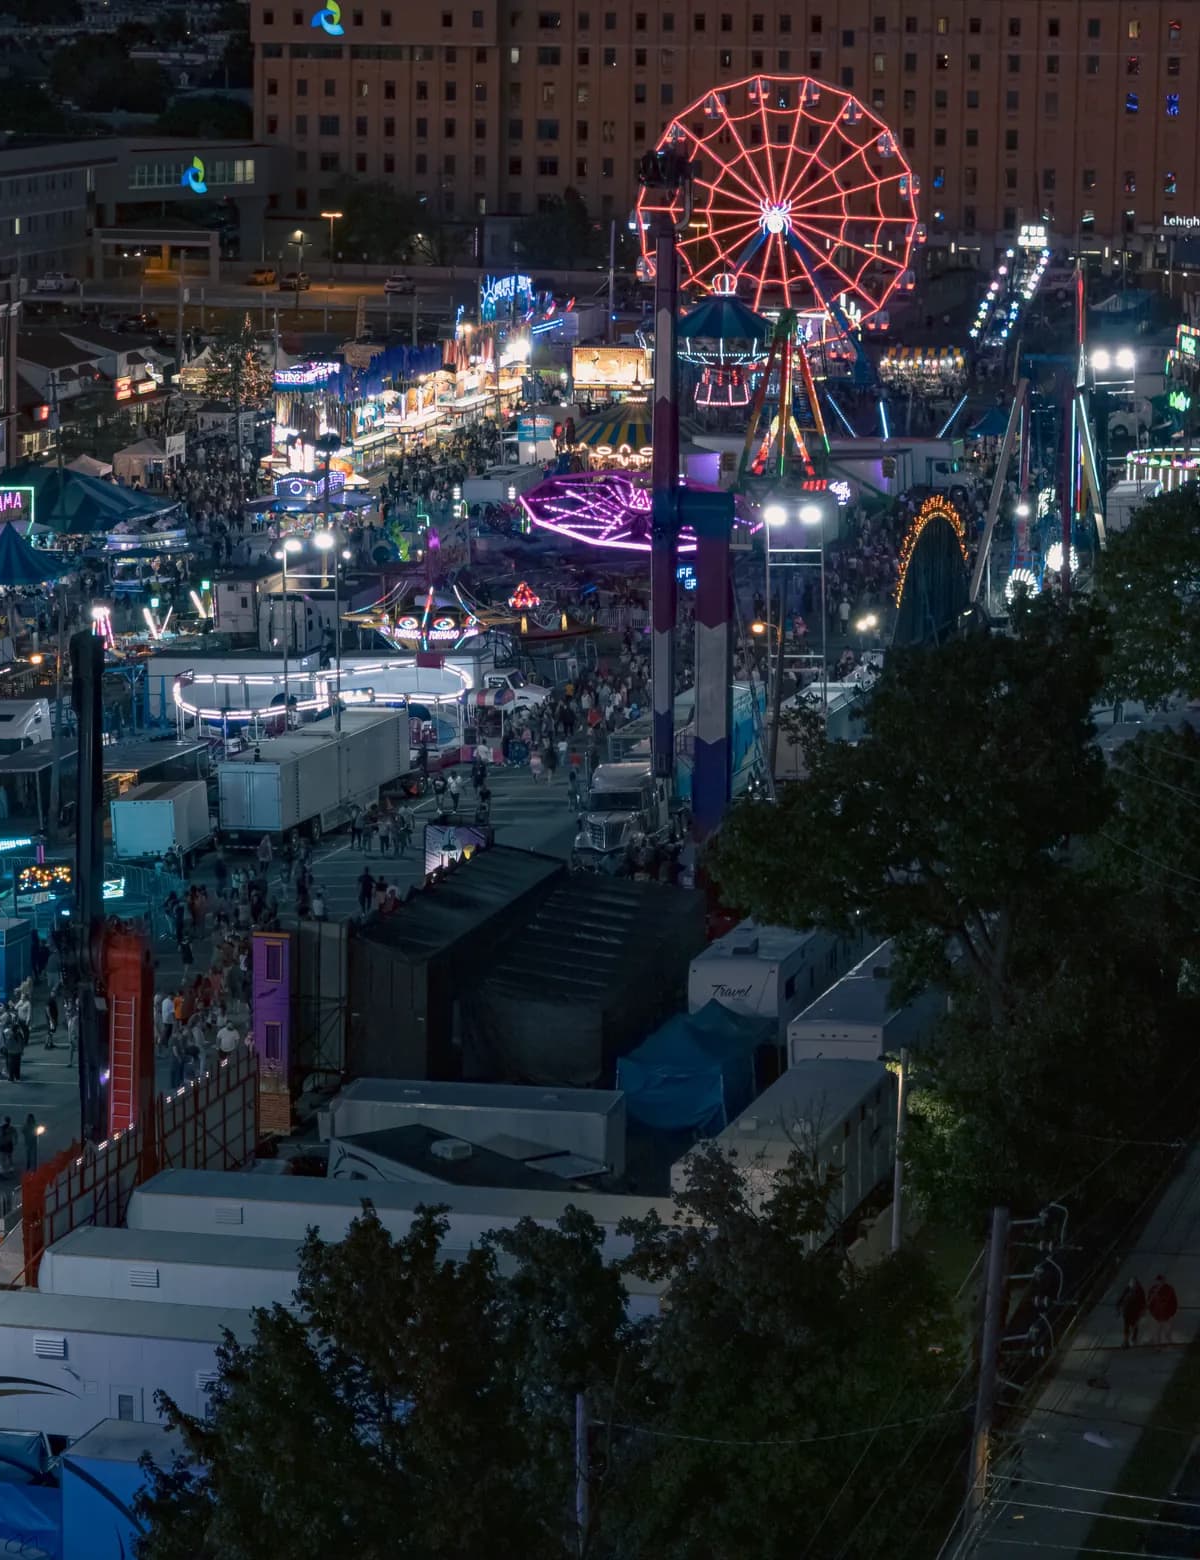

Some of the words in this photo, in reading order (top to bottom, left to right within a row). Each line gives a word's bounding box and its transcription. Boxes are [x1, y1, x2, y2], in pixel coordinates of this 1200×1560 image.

[1163, 215, 1200, 229] Lehigh
[428, 629, 460, 640] TORNADO
[711, 984, 753, 999] Travel
